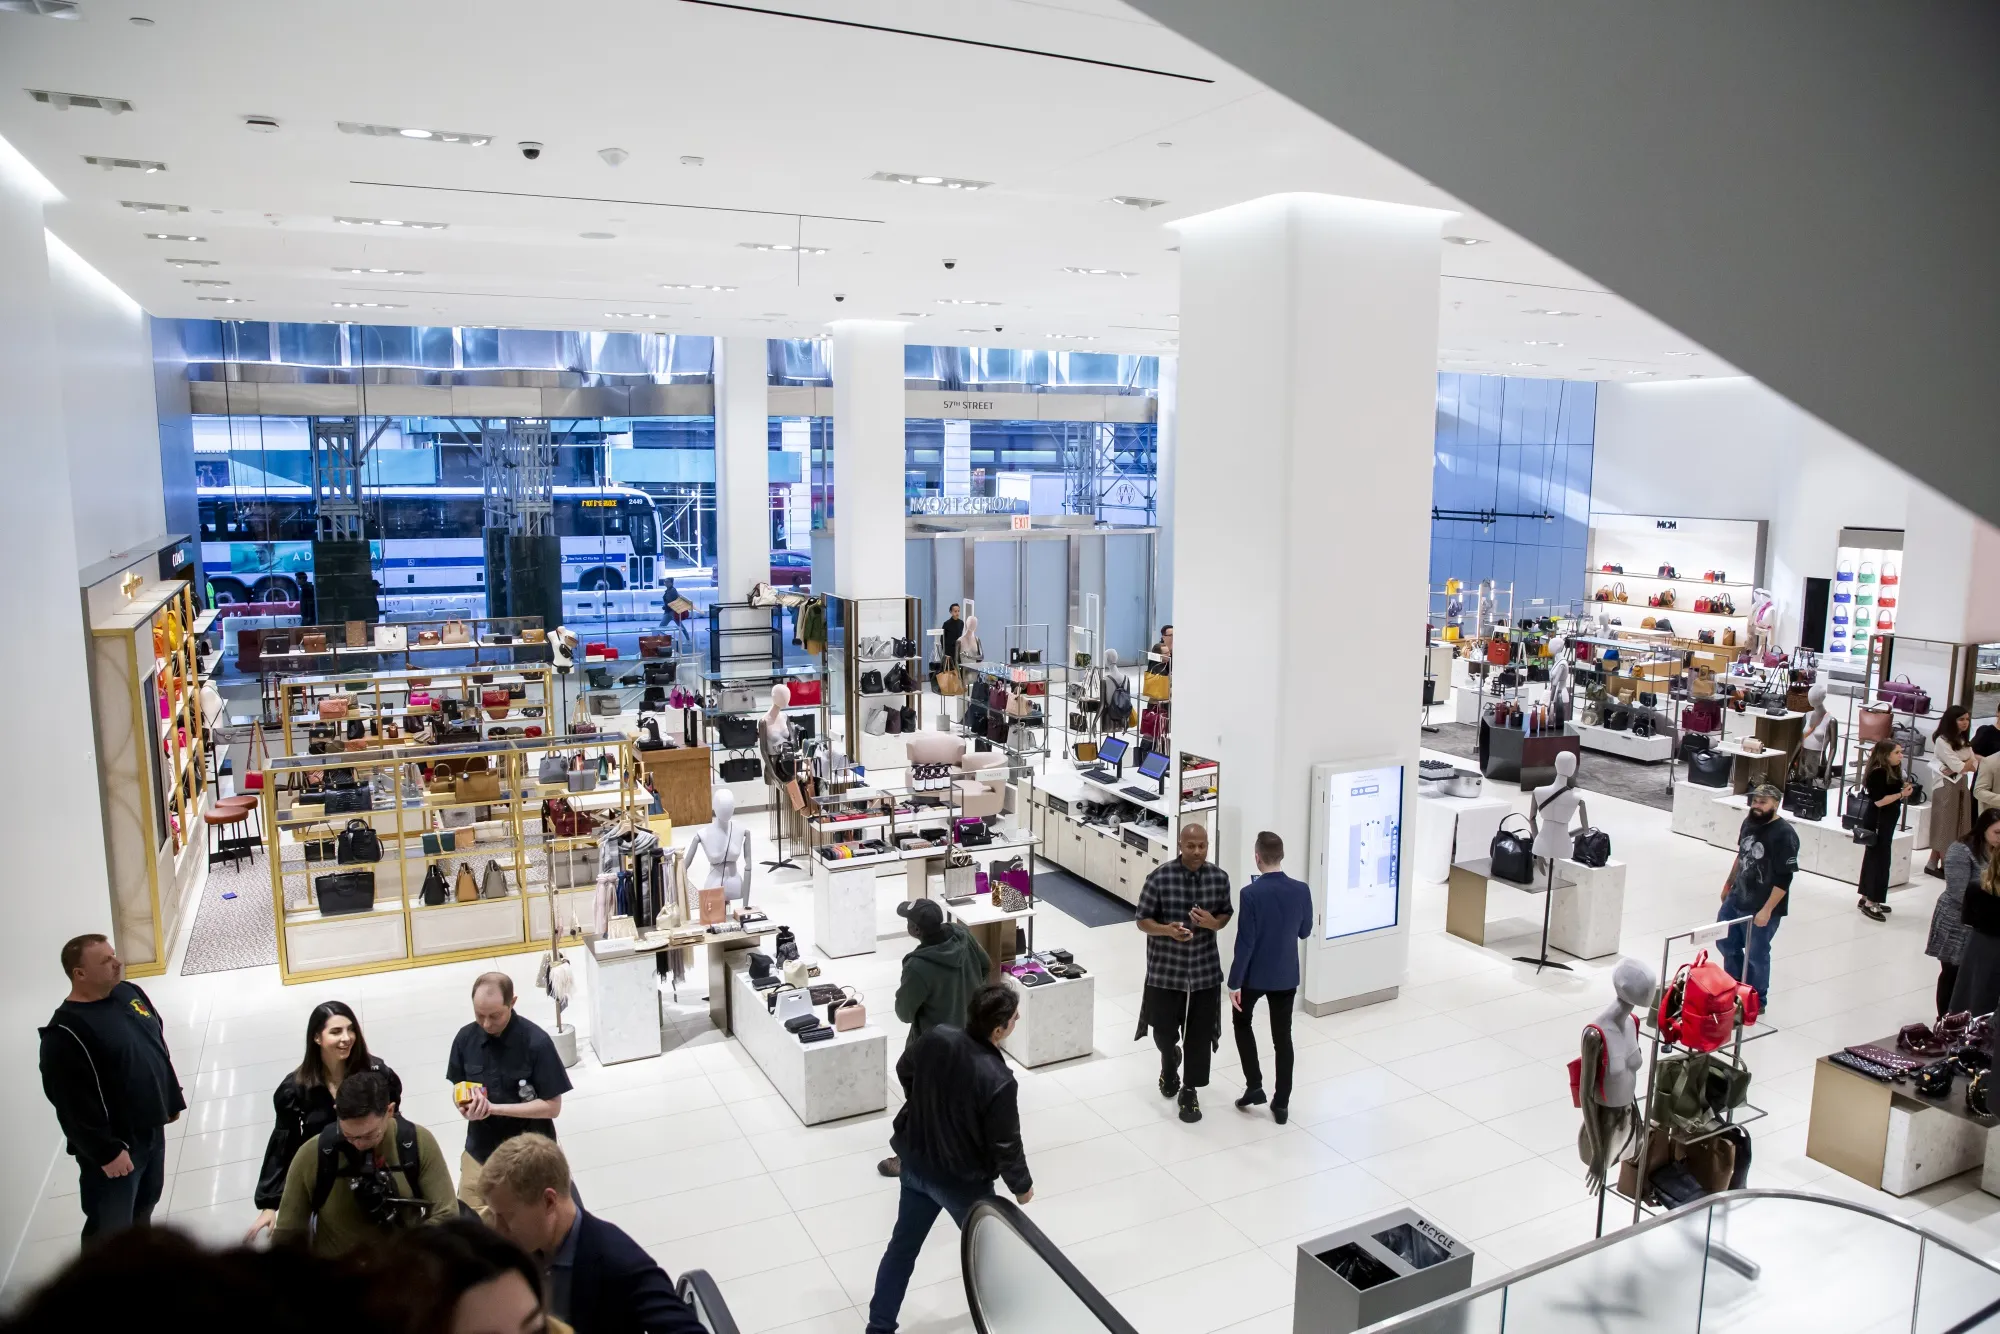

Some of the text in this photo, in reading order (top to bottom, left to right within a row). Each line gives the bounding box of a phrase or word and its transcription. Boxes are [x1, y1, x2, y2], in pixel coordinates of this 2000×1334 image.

[944, 400, 994, 410] 57TH STREET
[1014, 517, 1029, 529] EXIT
[1656, 520, 1676, 529] MCM
[1416, 1220, 1455, 1249] RECYCLE
